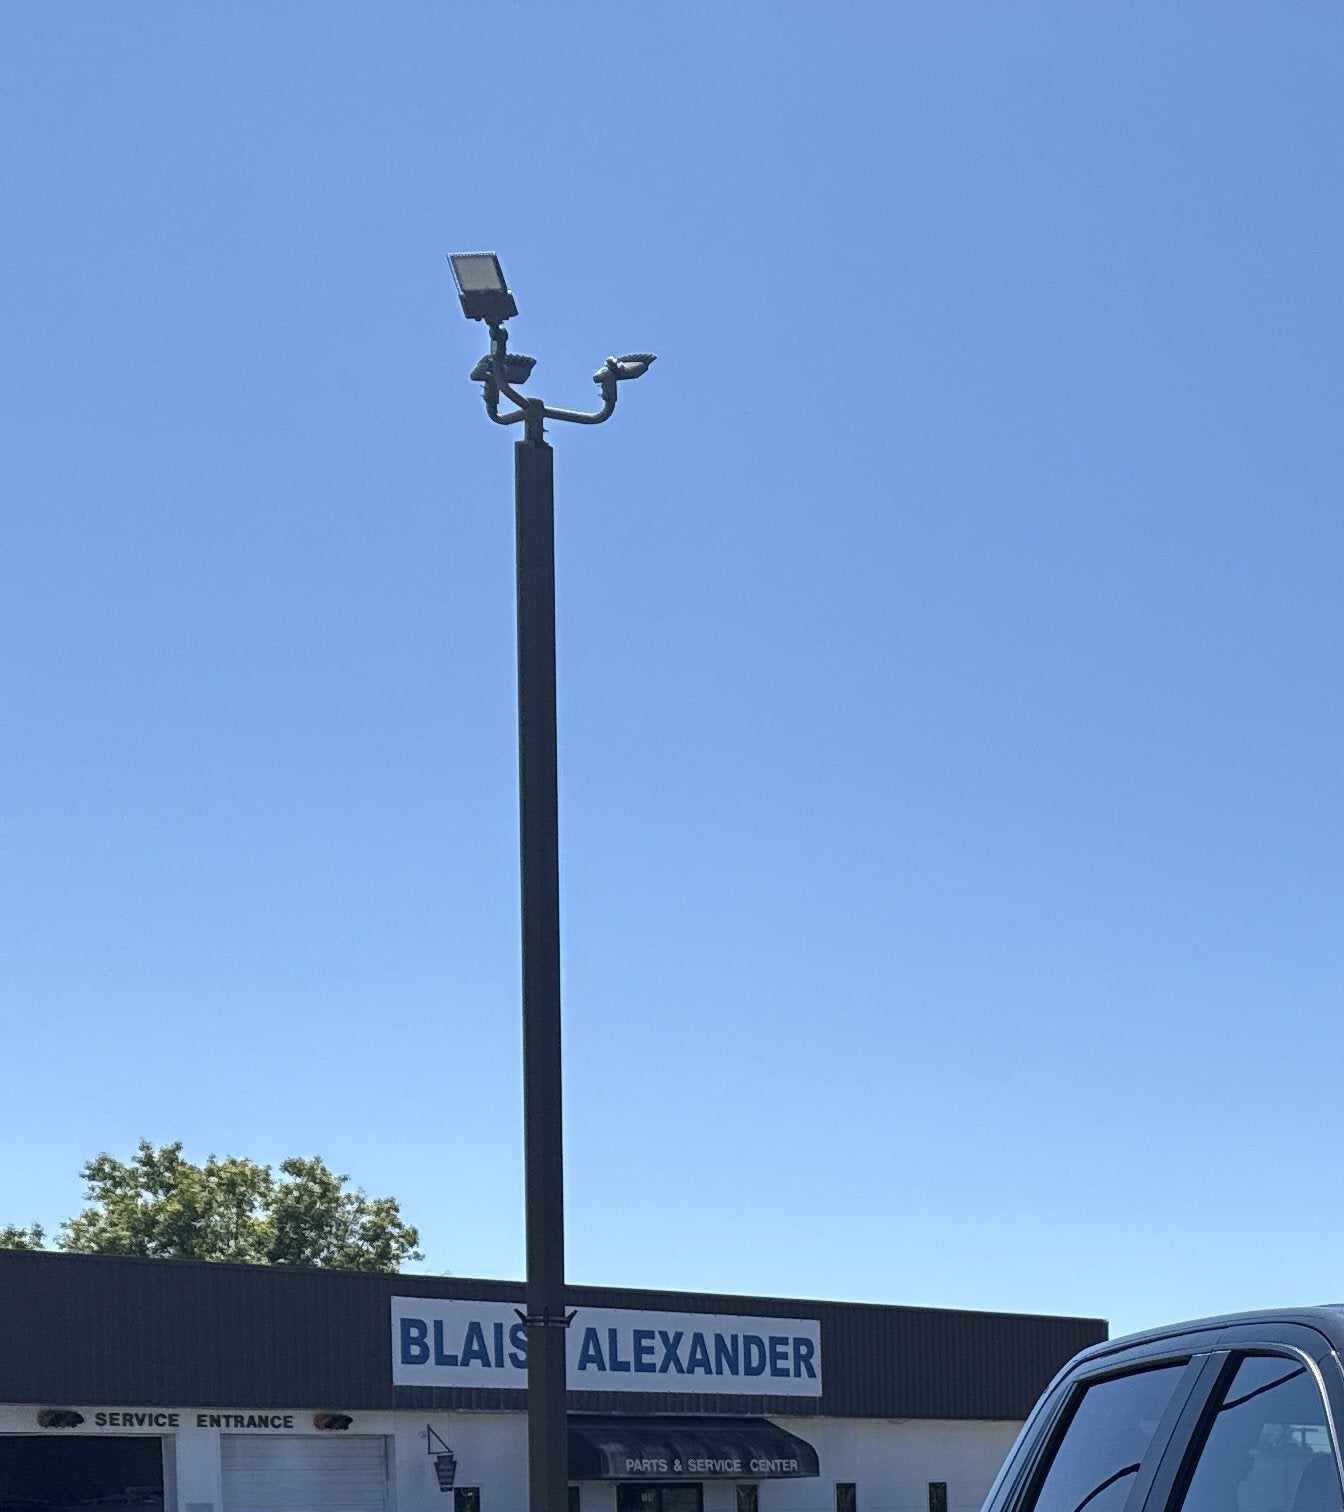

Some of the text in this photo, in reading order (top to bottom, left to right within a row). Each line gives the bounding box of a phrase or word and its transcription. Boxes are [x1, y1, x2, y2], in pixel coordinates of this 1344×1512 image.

[400, 1317, 817, 1379] BLAIS ALEXANDER
[95, 1412, 294, 1429] SERVICE ENTRANCE
[625, 1457, 798, 1473] PARTS & SERVICE CENTER
